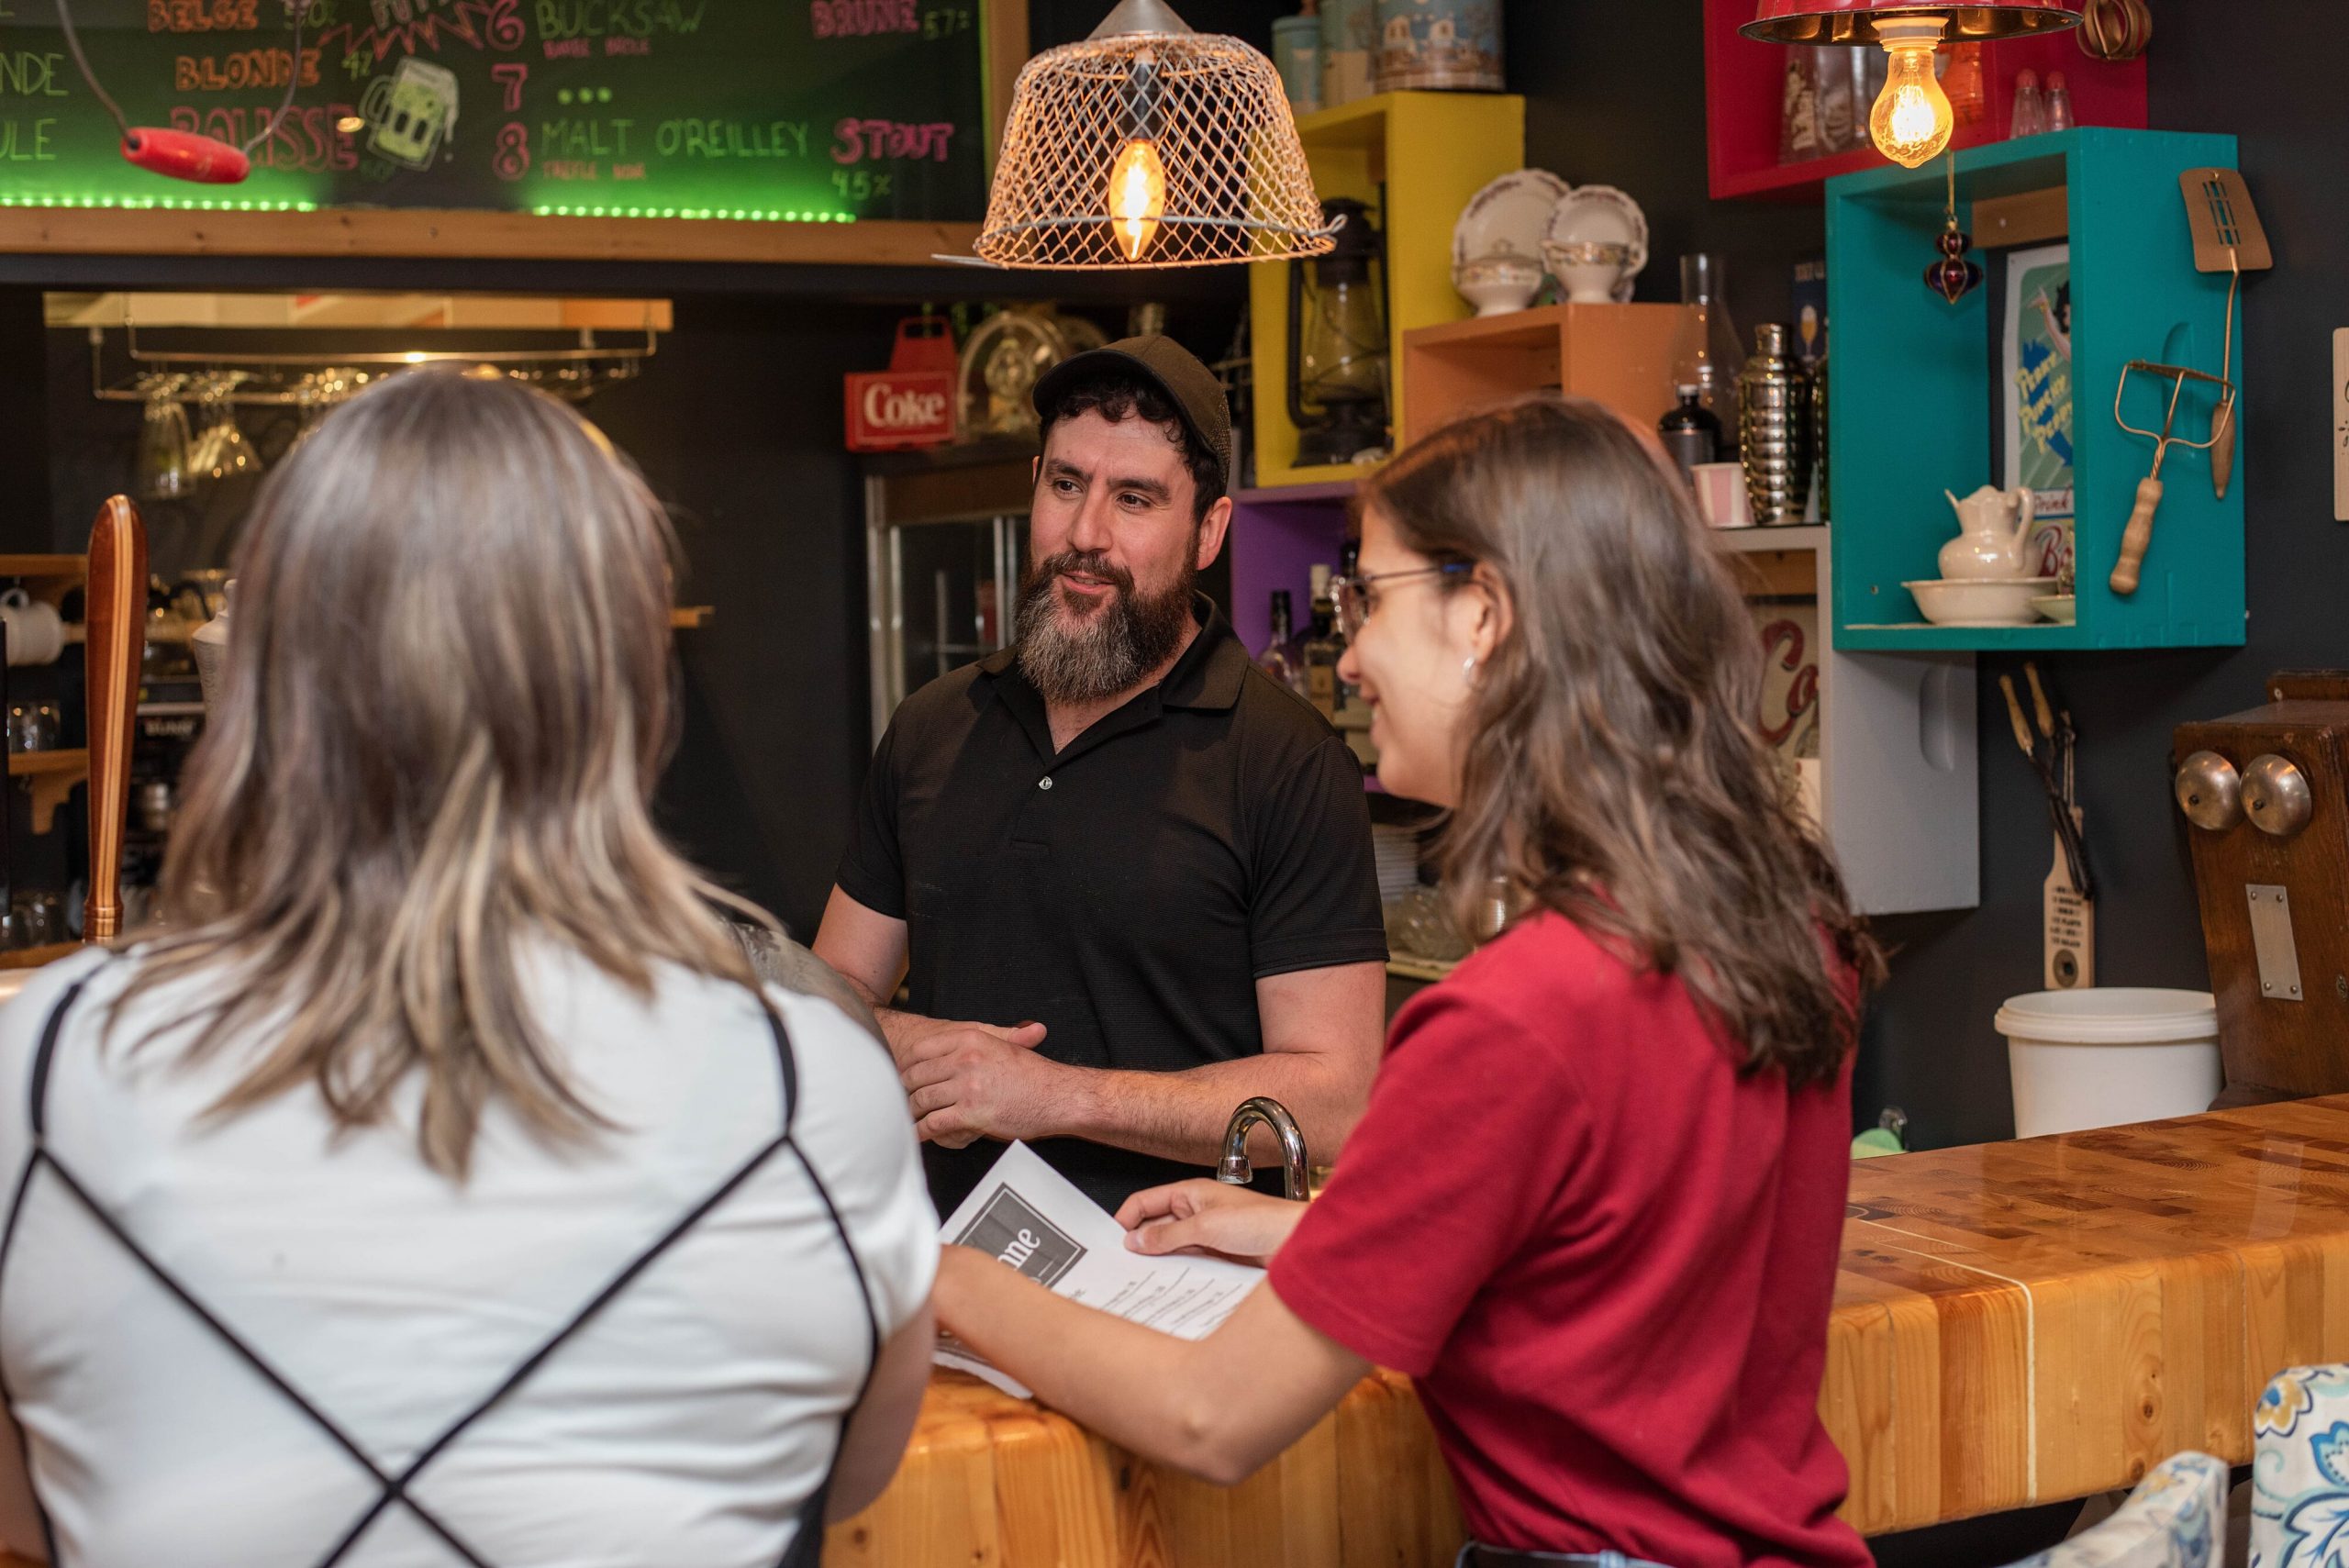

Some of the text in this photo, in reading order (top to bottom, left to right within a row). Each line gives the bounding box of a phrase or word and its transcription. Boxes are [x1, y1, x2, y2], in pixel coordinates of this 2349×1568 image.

[147, 0, 259, 33] BELGE
[485, 0, 526, 51] 6
[175, 48, 320, 91] BLONDE
[491, 62, 529, 111] 7
[492, 121, 530, 182] 8
[541, 118, 633, 158] MALT
[829, 117, 954, 165] STOUT
[864, 383, 946, 428] Coke
